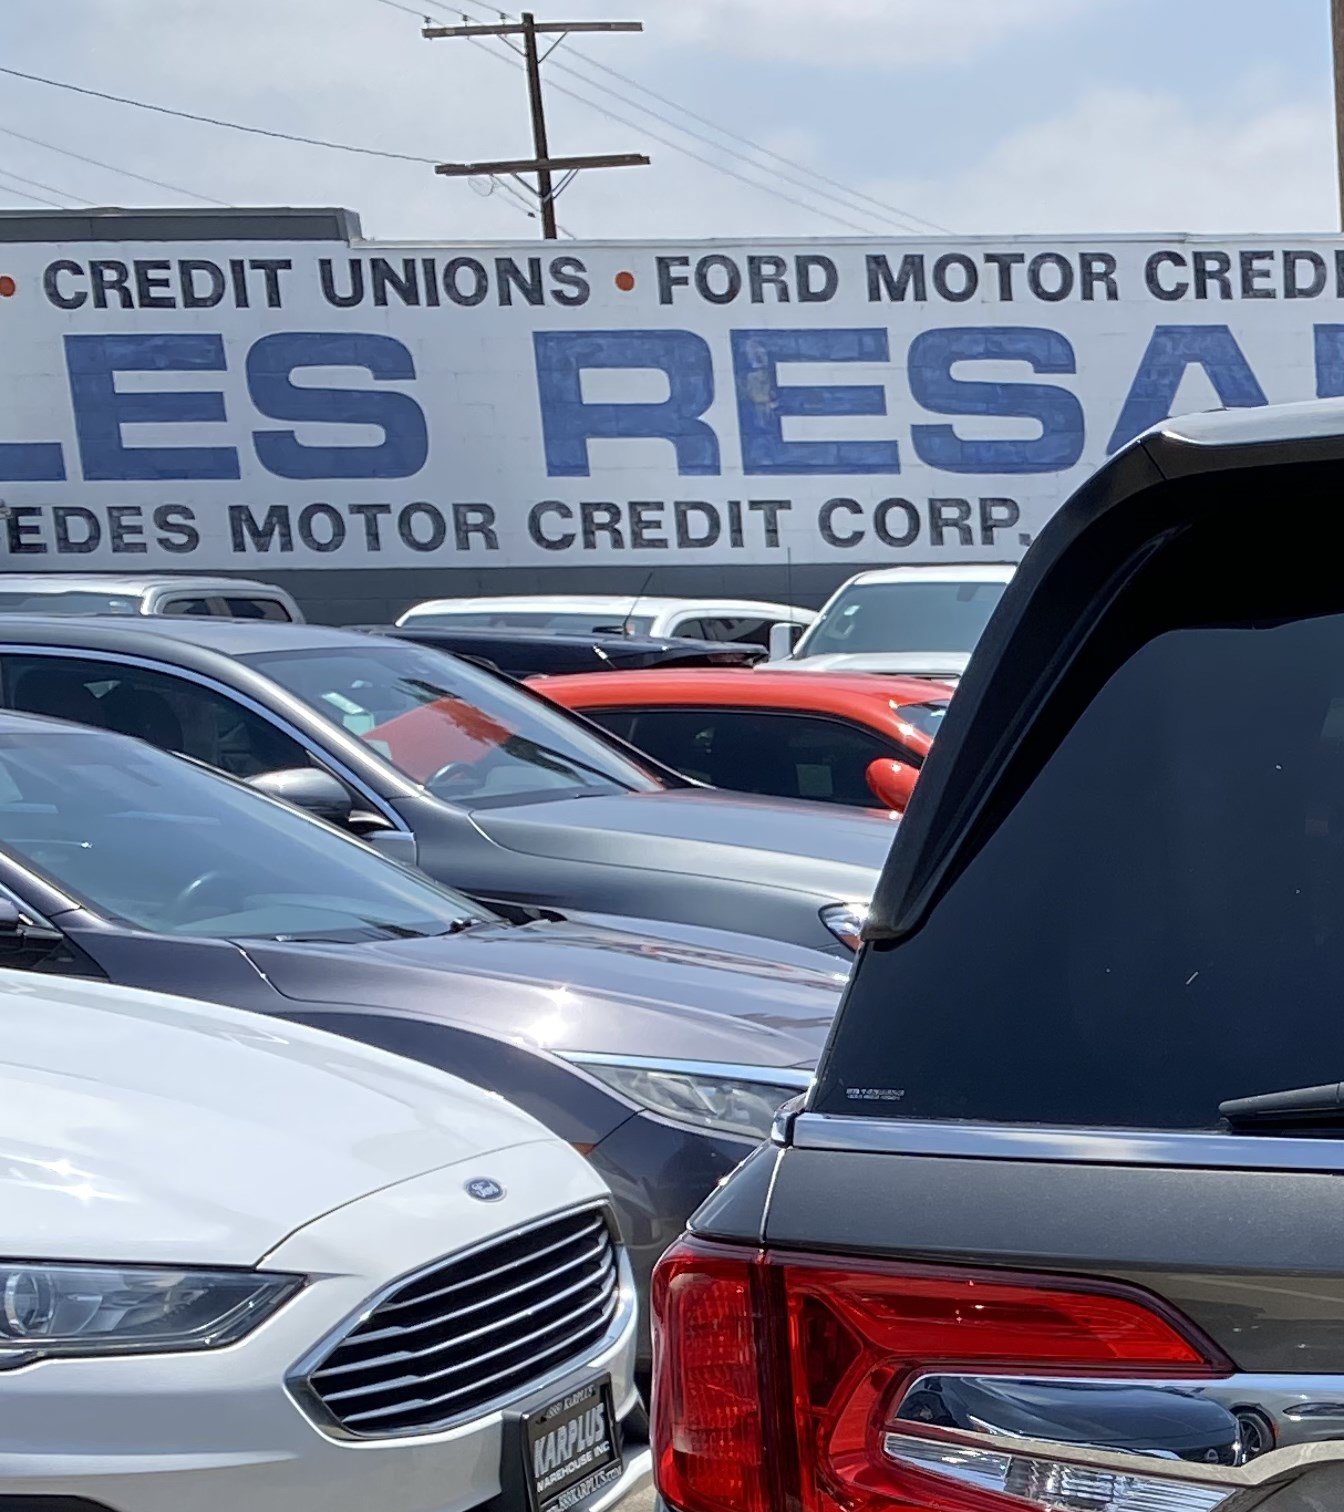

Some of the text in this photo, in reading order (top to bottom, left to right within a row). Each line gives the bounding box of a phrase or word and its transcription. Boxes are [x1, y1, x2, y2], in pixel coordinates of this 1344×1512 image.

[43, 258, 292, 309] CREDIT
[318, 256, 590, 307] UNIONS
[655, 253, 839, 304] FORD
[865, 251, 1118, 303] MOTOR
[228, 501, 500, 553] MOTOR
[528, 499, 792, 550] CREDIT
[818, 497, 1032, 548] CORP.
[534, 1402, 605, 1479] KARPLUS
